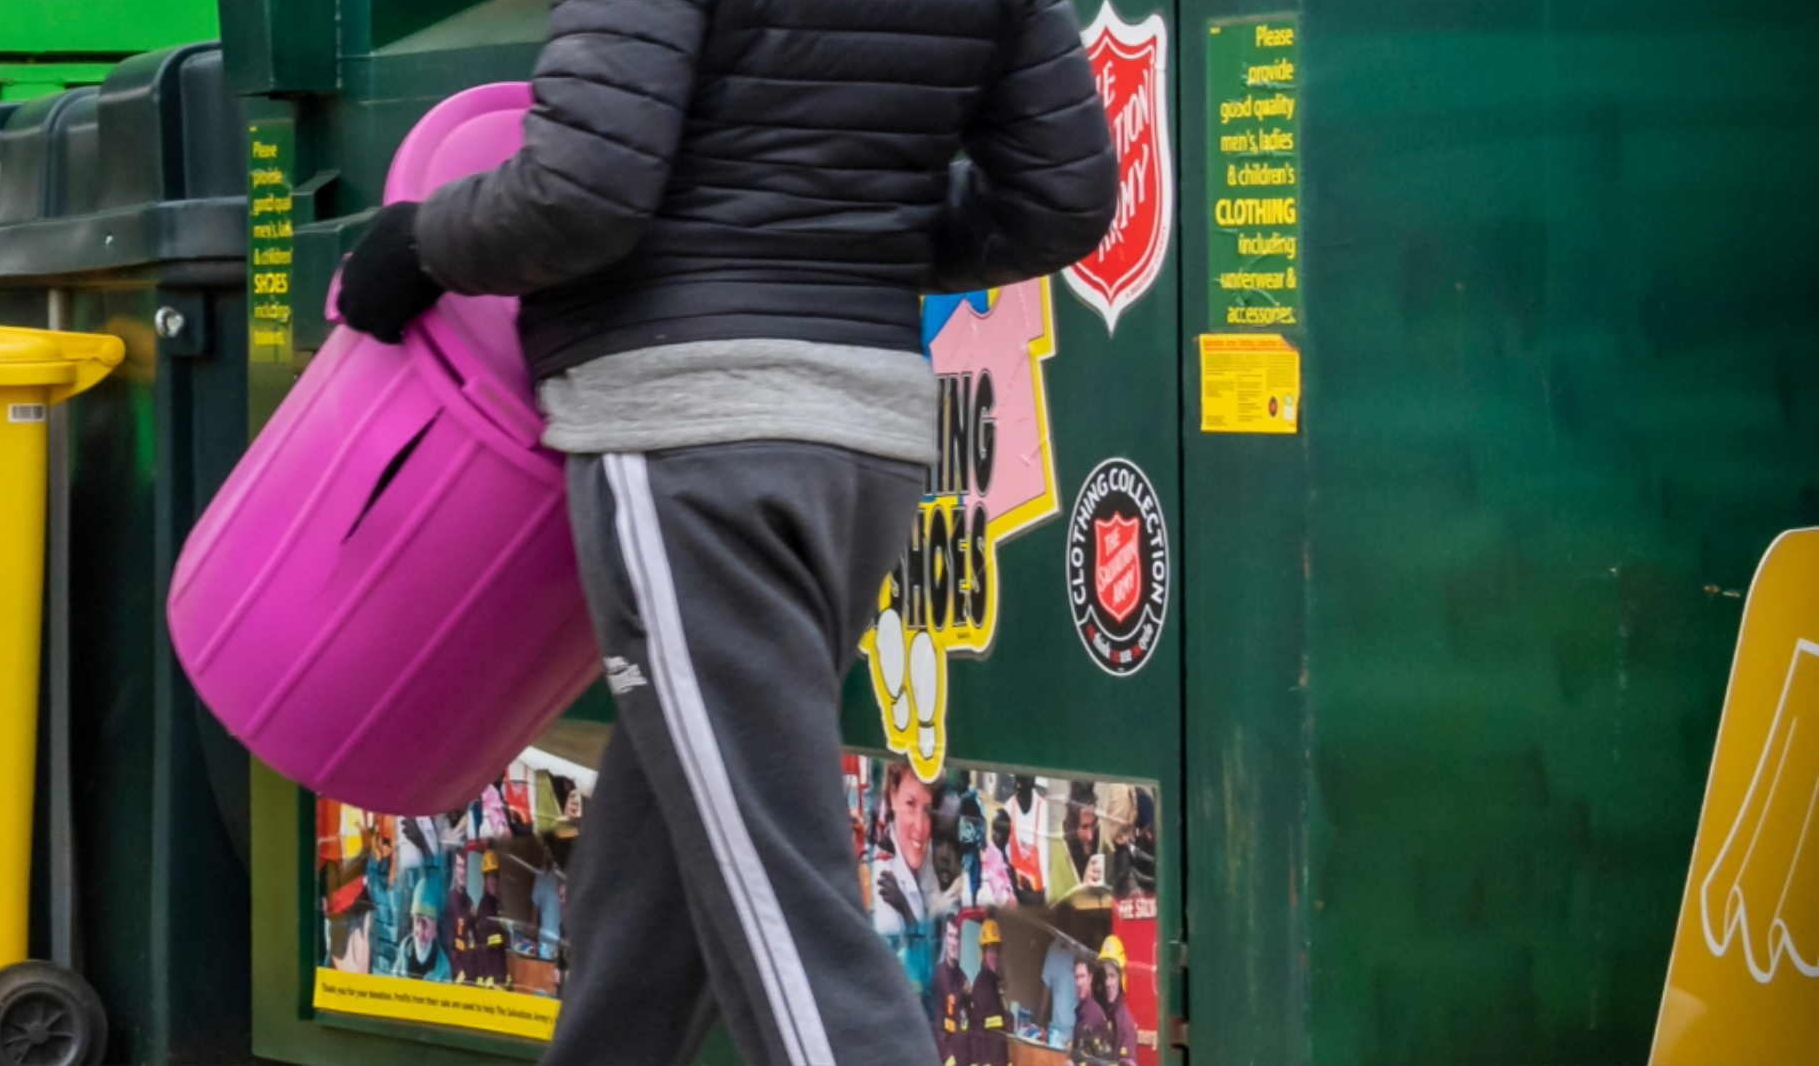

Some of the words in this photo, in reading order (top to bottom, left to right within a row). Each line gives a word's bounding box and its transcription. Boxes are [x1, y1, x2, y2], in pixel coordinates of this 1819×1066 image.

[1255, 25, 1294, 47] Please
[1247, 59, 1294, 85] provide
[1221, 95, 1252, 124] good
[1254, 94, 1294, 121] quality
[1258, 128, 1293, 151] ladies
[1227, 165, 1237, 186] &
[1238, 163, 1295, 185] children's
[1215, 198, 1296, 226] CLOTHING
[1238, 232, 1296, 259] including
[254, 273, 288, 293] SHOES
[1221, 269, 1284, 290] underwear
[1286, 267, 1296, 289] &
[1070, 473, 1109, 605] CLOTHING
[1109, 467, 1166, 605] COLLECTION
